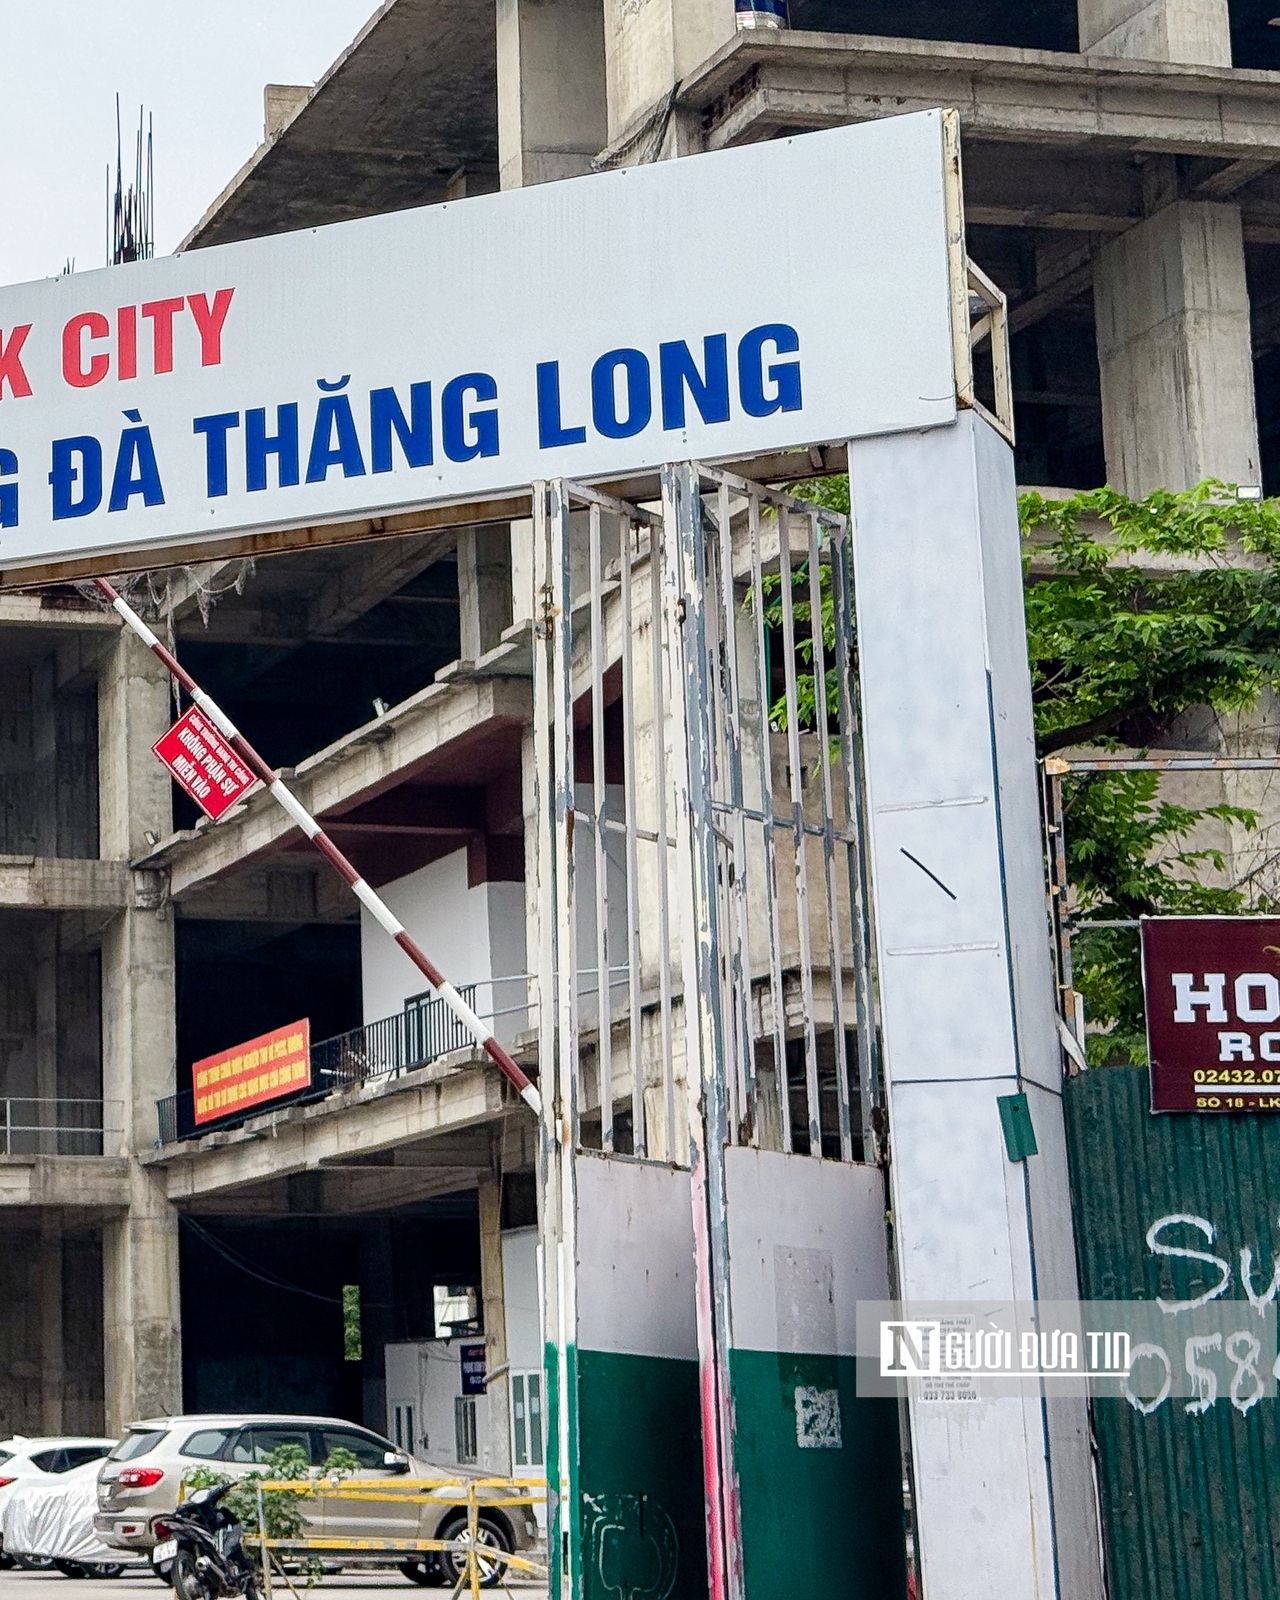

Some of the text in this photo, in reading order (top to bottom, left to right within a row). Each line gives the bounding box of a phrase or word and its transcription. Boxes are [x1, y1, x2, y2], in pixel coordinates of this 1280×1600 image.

[61, 287, 235, 389] CITY
[48, 408, 166, 521] ĐÀ
[193, 374, 500, 498] THĂNG
[536, 323, 803, 450] LONG
[177, 726, 241, 798] KHÔNG PHẬN SỰ
[190, 775, 212, 799] VÀO
[1226, 1097, 1244, 1108] 18
